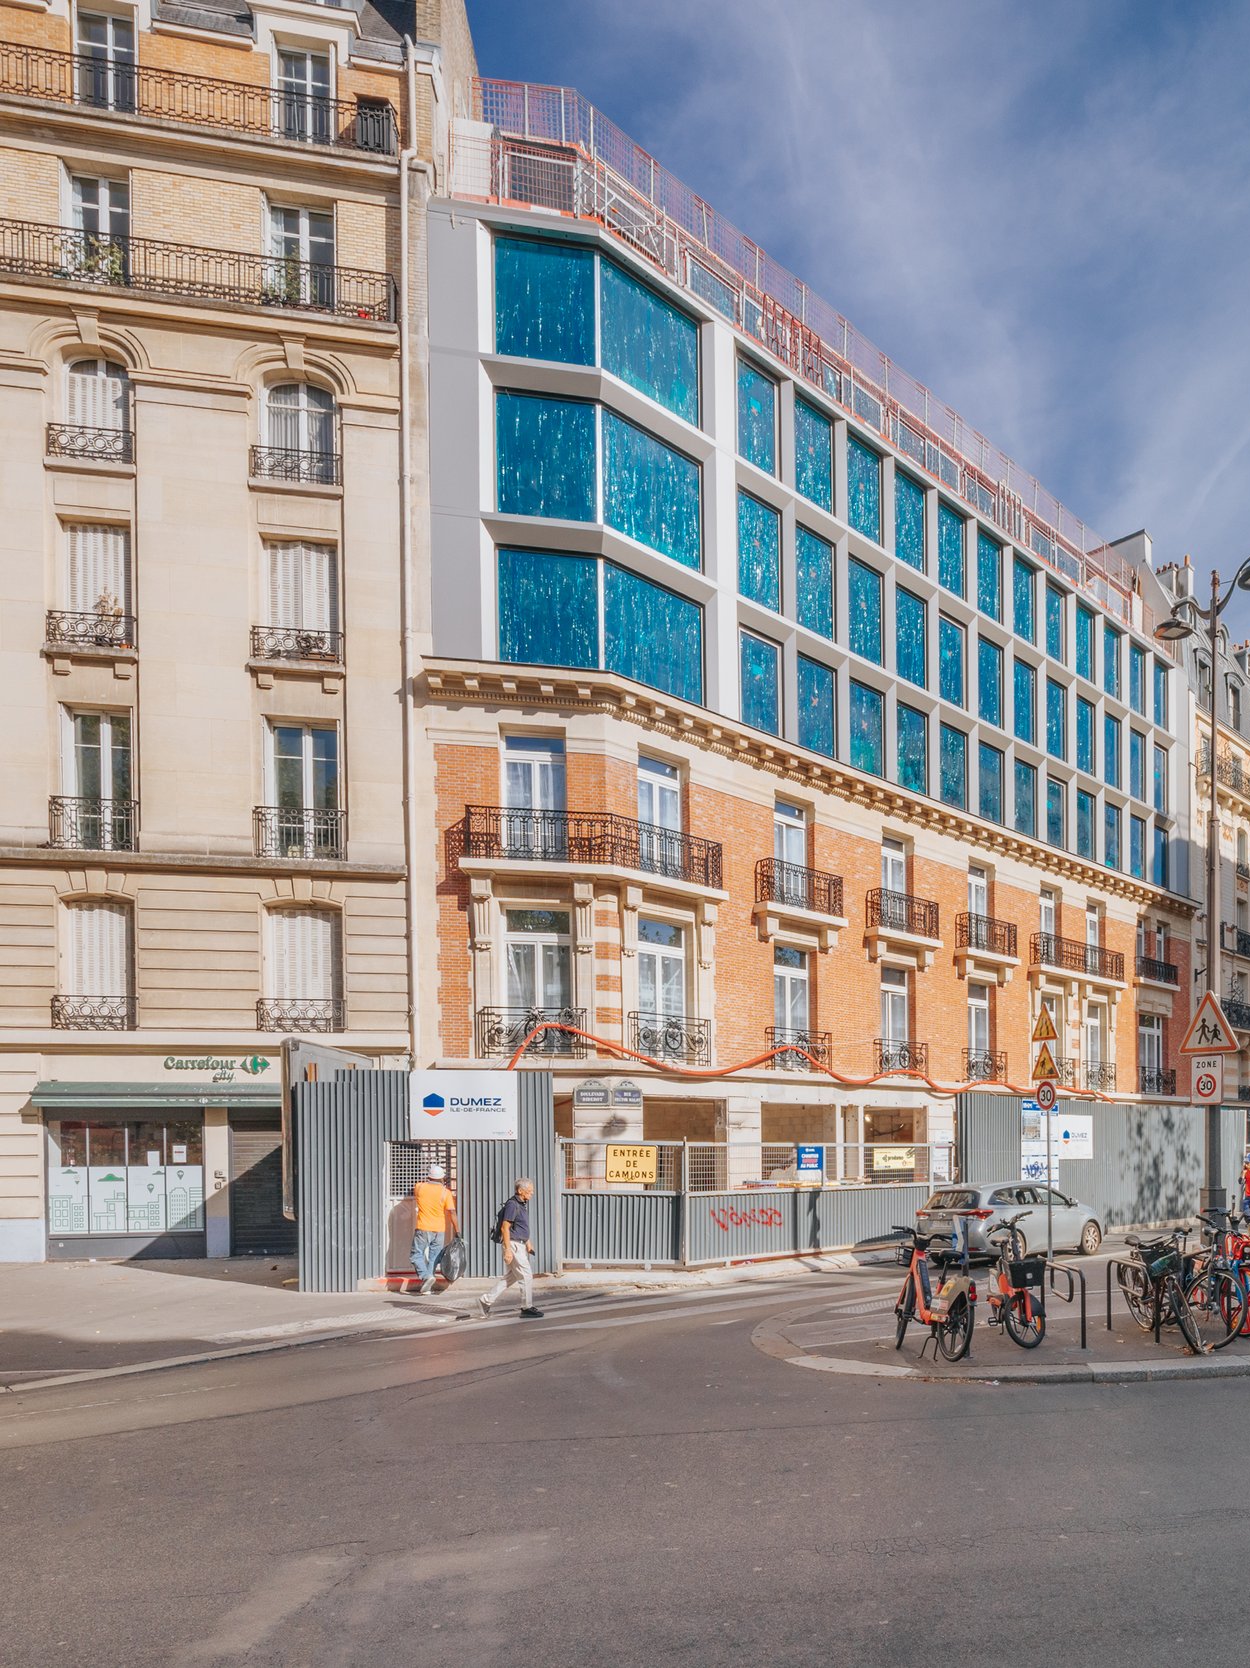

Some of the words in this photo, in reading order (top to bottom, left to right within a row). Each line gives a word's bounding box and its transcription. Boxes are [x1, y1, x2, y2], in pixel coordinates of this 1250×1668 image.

[163, 1056, 237, 1070] Carrefour
[1196, 1060, 1217, 1069] ZONE
[212, 1068, 235, 1083] city
[1200, 1080, 1213, 1091] 30
[1040, 1089, 1052, 1102] 30
[450, 1097, 502, 1106] DUMEZ
[613, 1148, 651, 1158] ENTRÉE
[626, 1160, 638, 1168] DE
[609, 1171, 654, 1179] CAMIONS
